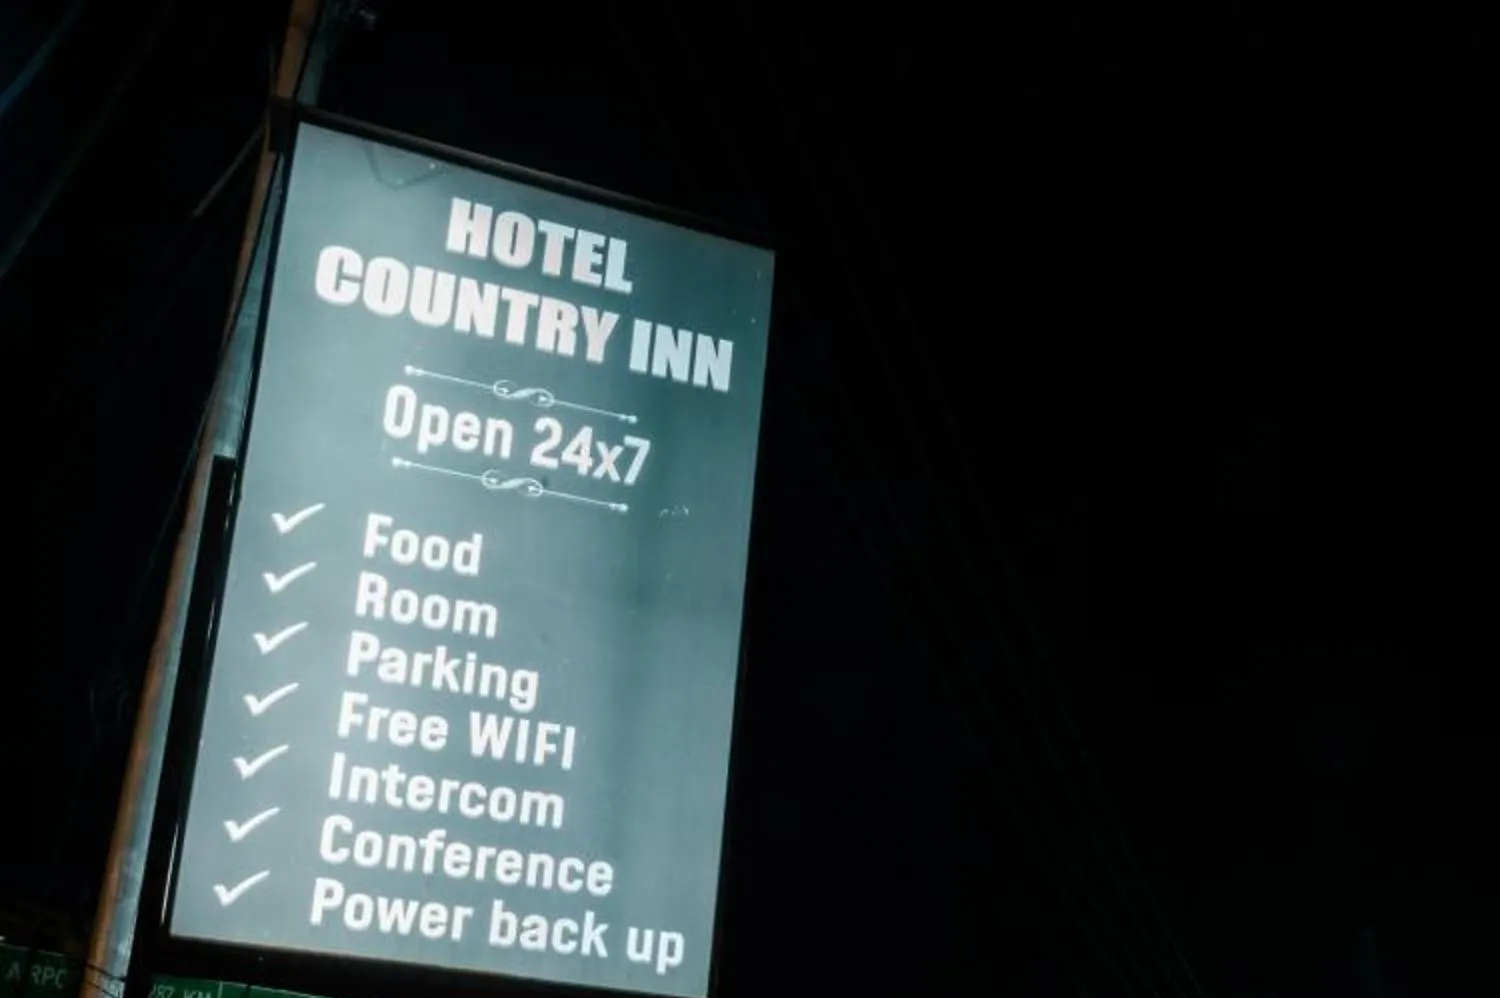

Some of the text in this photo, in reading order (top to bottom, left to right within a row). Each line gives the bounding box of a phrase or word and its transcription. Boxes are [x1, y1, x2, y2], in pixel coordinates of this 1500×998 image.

[445, 197, 632, 294] HOTEL
[315, 246, 734, 392] COUNTRY INN
[382, 384, 652, 486] Open 24x7
[363, 513, 483, 577] Food
[354, 572, 499, 638] Room
[346, 631, 539, 712] Parking
[337, 691, 576, 771] Free WIFI
[328, 753, 566, 829] Intercom
[318, 814, 615, 896] Conference
[310, 878, 686, 974] Power back up
